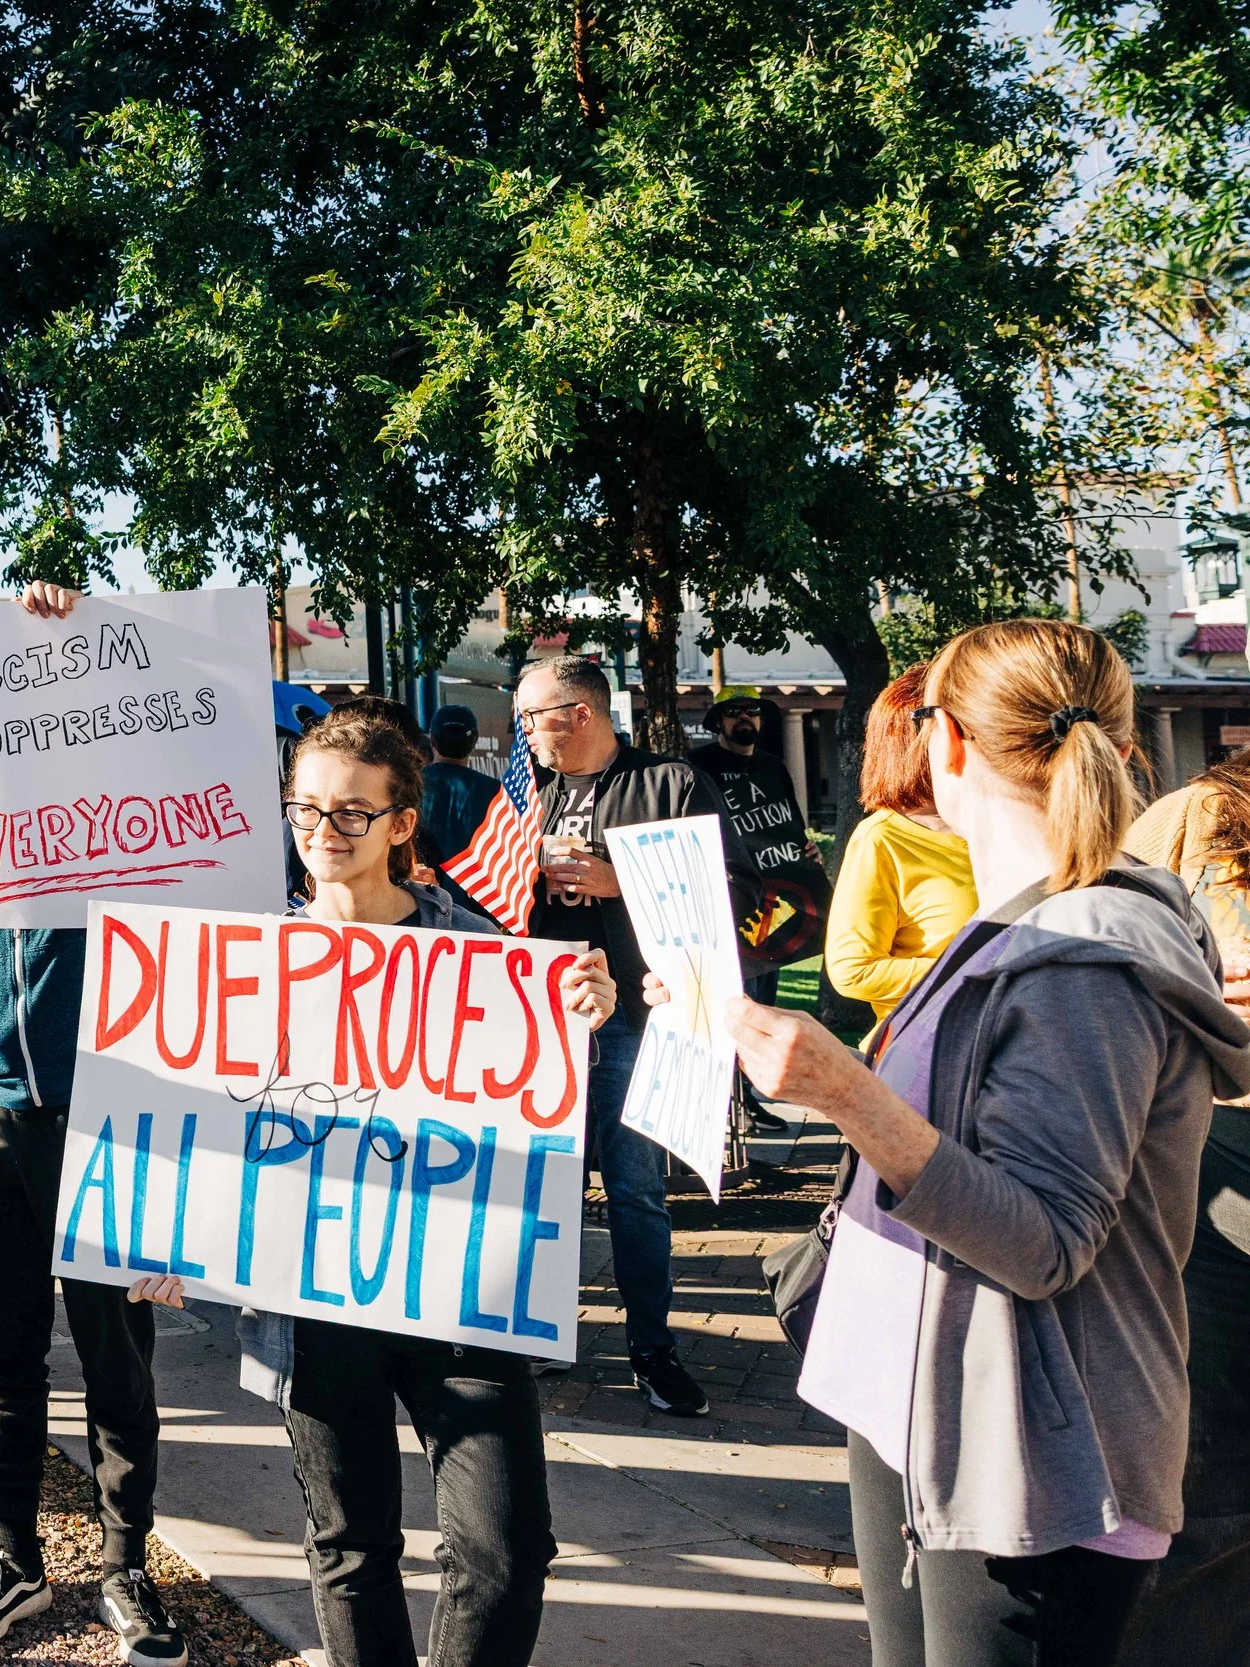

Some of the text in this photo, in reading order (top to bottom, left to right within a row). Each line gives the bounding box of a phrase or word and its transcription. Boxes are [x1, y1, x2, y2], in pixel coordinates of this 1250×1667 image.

[749, 781, 767, 803] A
[755, 842, 801, 871] KING
[95, 914, 584, 1129] DUE PROCESS
[60, 1109, 577, 1342] ALL PEOPLE
